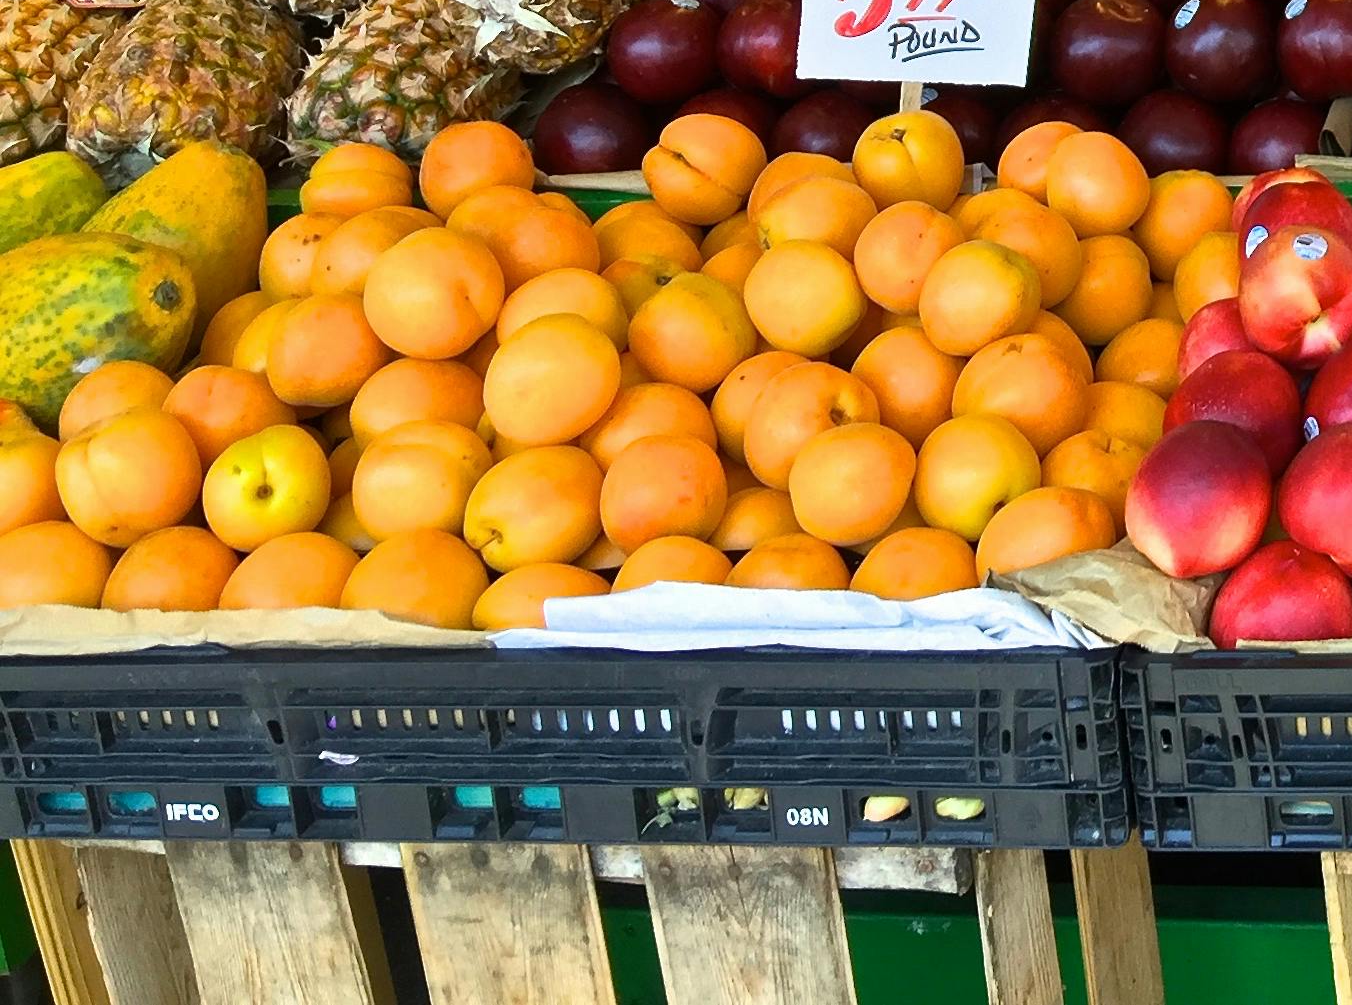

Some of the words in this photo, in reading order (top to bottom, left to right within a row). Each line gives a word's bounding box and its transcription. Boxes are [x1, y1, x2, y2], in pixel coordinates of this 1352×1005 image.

[888, 20, 981, 59] POUND
[166, 803, 220, 821] IFCO
[786, 807, 829, 826] 08N
